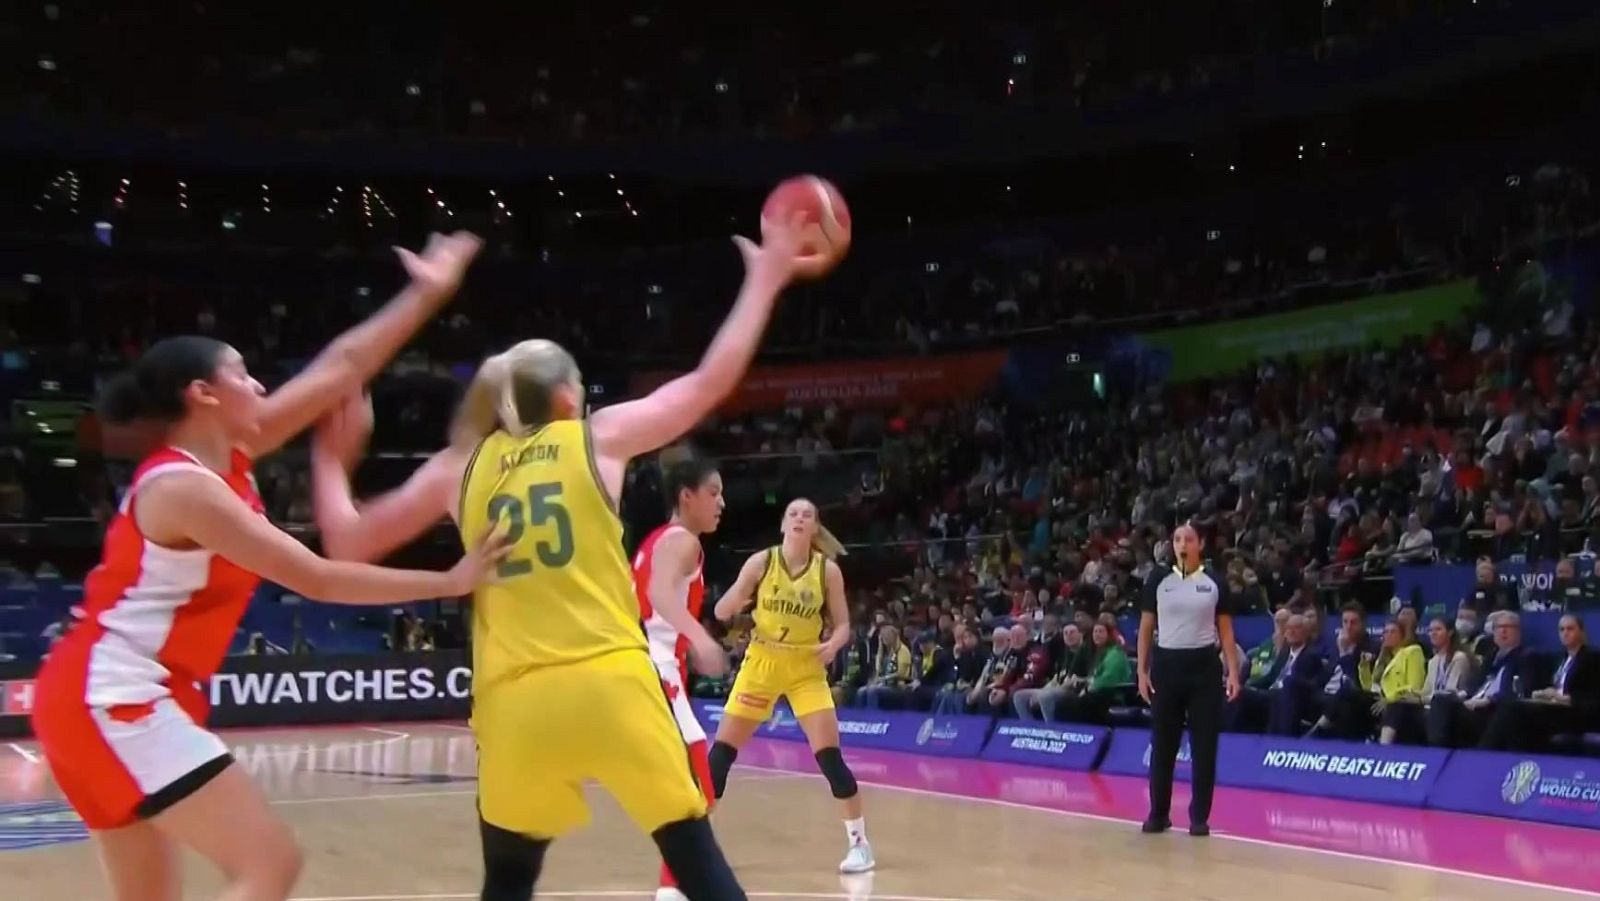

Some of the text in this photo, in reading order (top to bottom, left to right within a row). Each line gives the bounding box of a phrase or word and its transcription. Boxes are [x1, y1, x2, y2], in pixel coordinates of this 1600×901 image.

[488, 482, 574, 577] 25
[778, 627, 790, 642] 7
[210, 667, 472, 706] TWATCHES.C
[1263, 750, 1426, 781] NOTHING BEATS LIKE IT
[1540, 783, 1581, 799] WORLD
